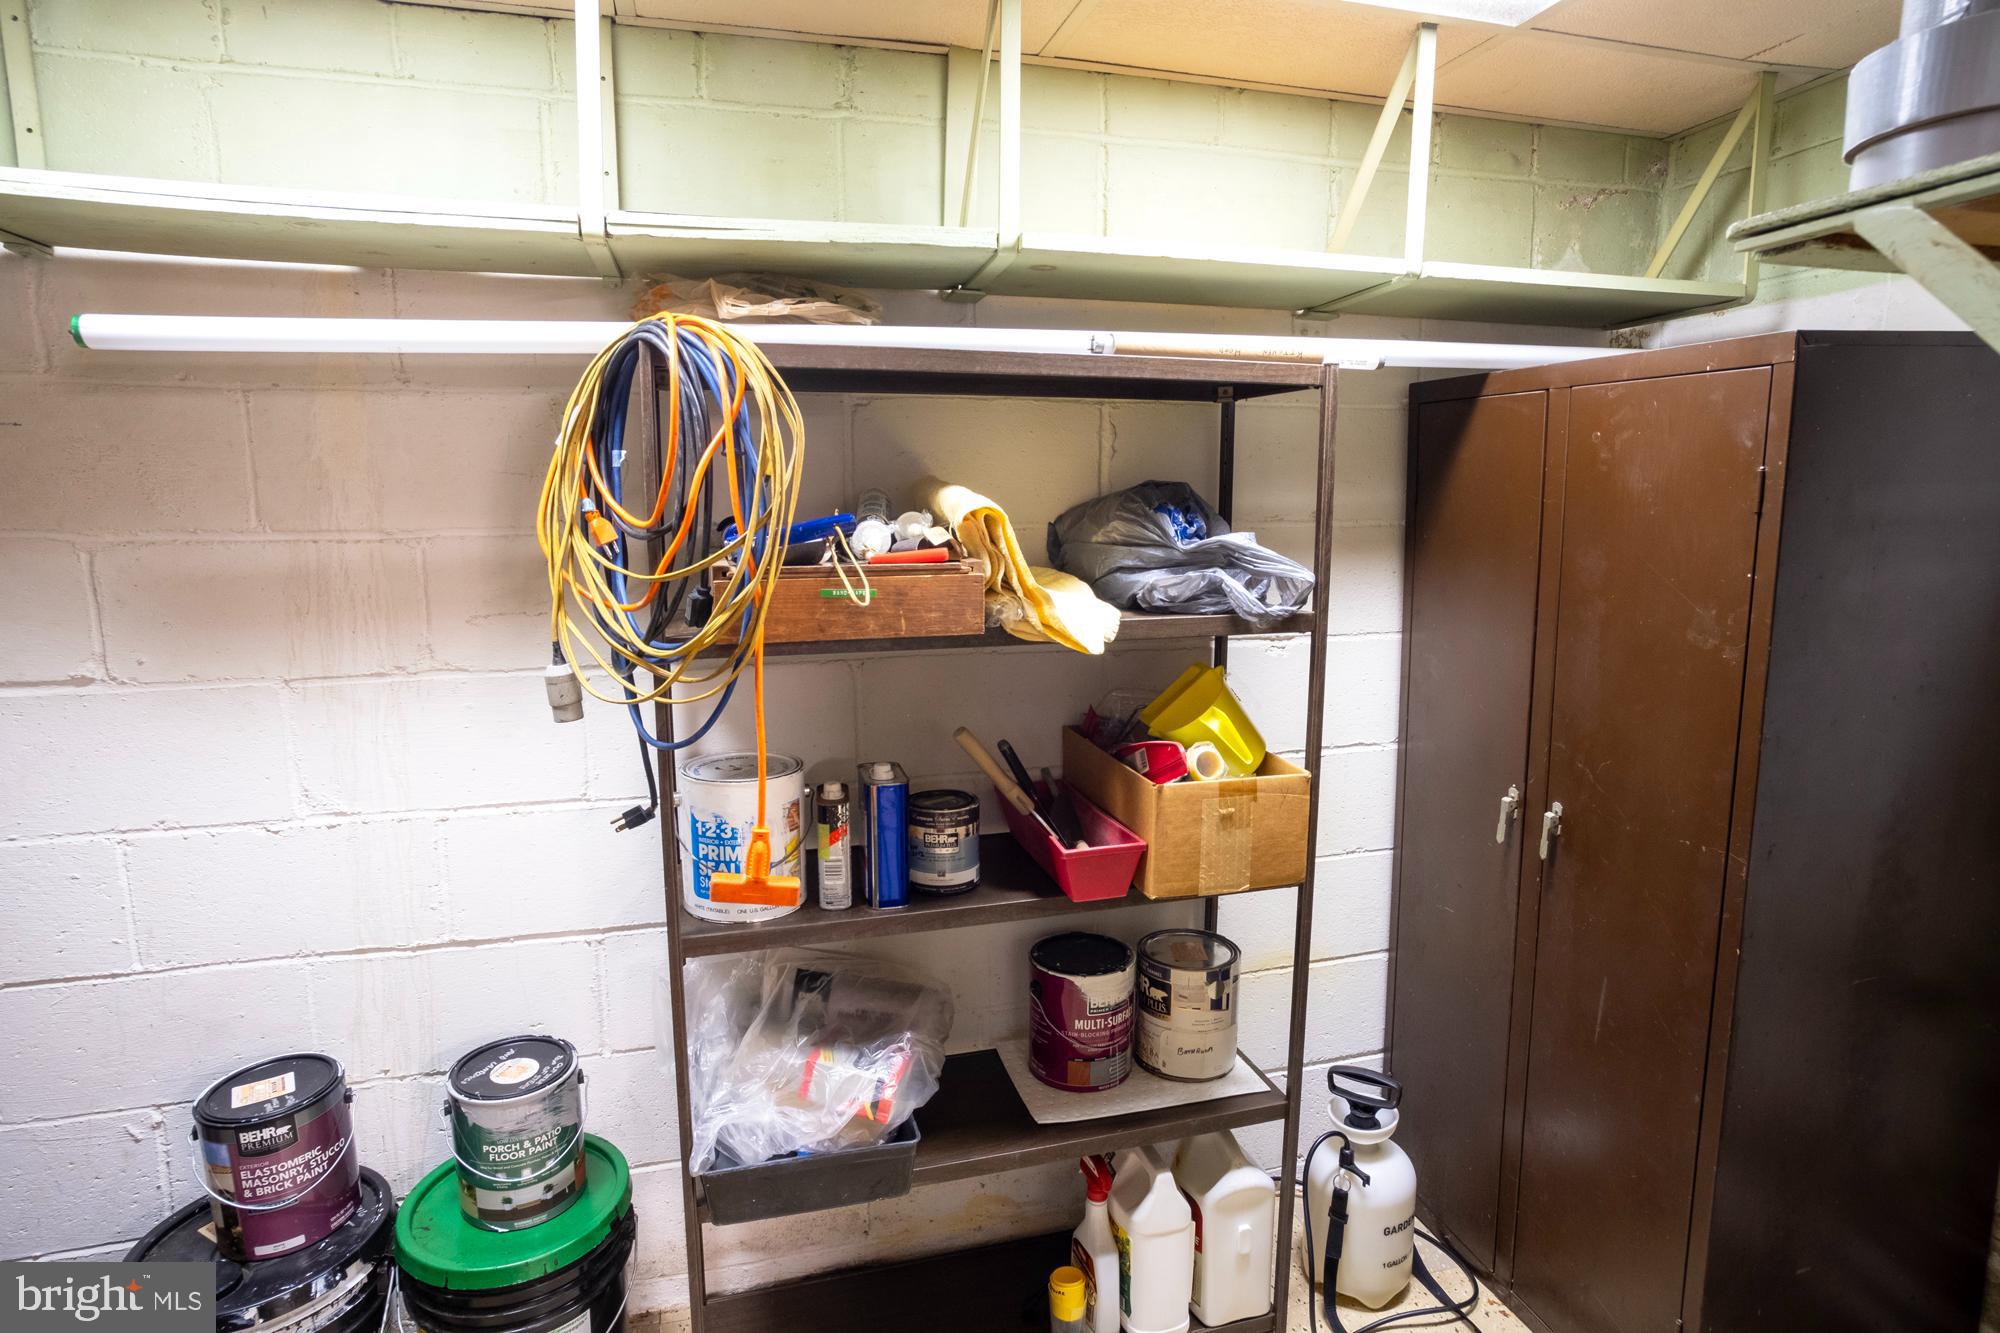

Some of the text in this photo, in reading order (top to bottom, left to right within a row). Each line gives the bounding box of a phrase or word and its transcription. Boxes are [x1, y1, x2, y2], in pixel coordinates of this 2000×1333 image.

[924, 834, 948, 843] BEHR
[699, 843, 741, 862] PRIM
[239, 1126, 277, 1144] BEHR
[241, 1131, 293, 1151] PREMIUM
[483, 1126, 562, 1153] PORCH & PATIO
[489, 1151, 526, 1162] FLOOR
[529, 1136, 558, 1156] PAINT
[240, 1145, 322, 1180] ELASTOMERIC
[242, 1137, 345, 1189] MASONRY, STUCCO
[243, 1160, 329, 1198] & BRICK PAINT
[1386, 1255, 1408, 1268] GALLON
